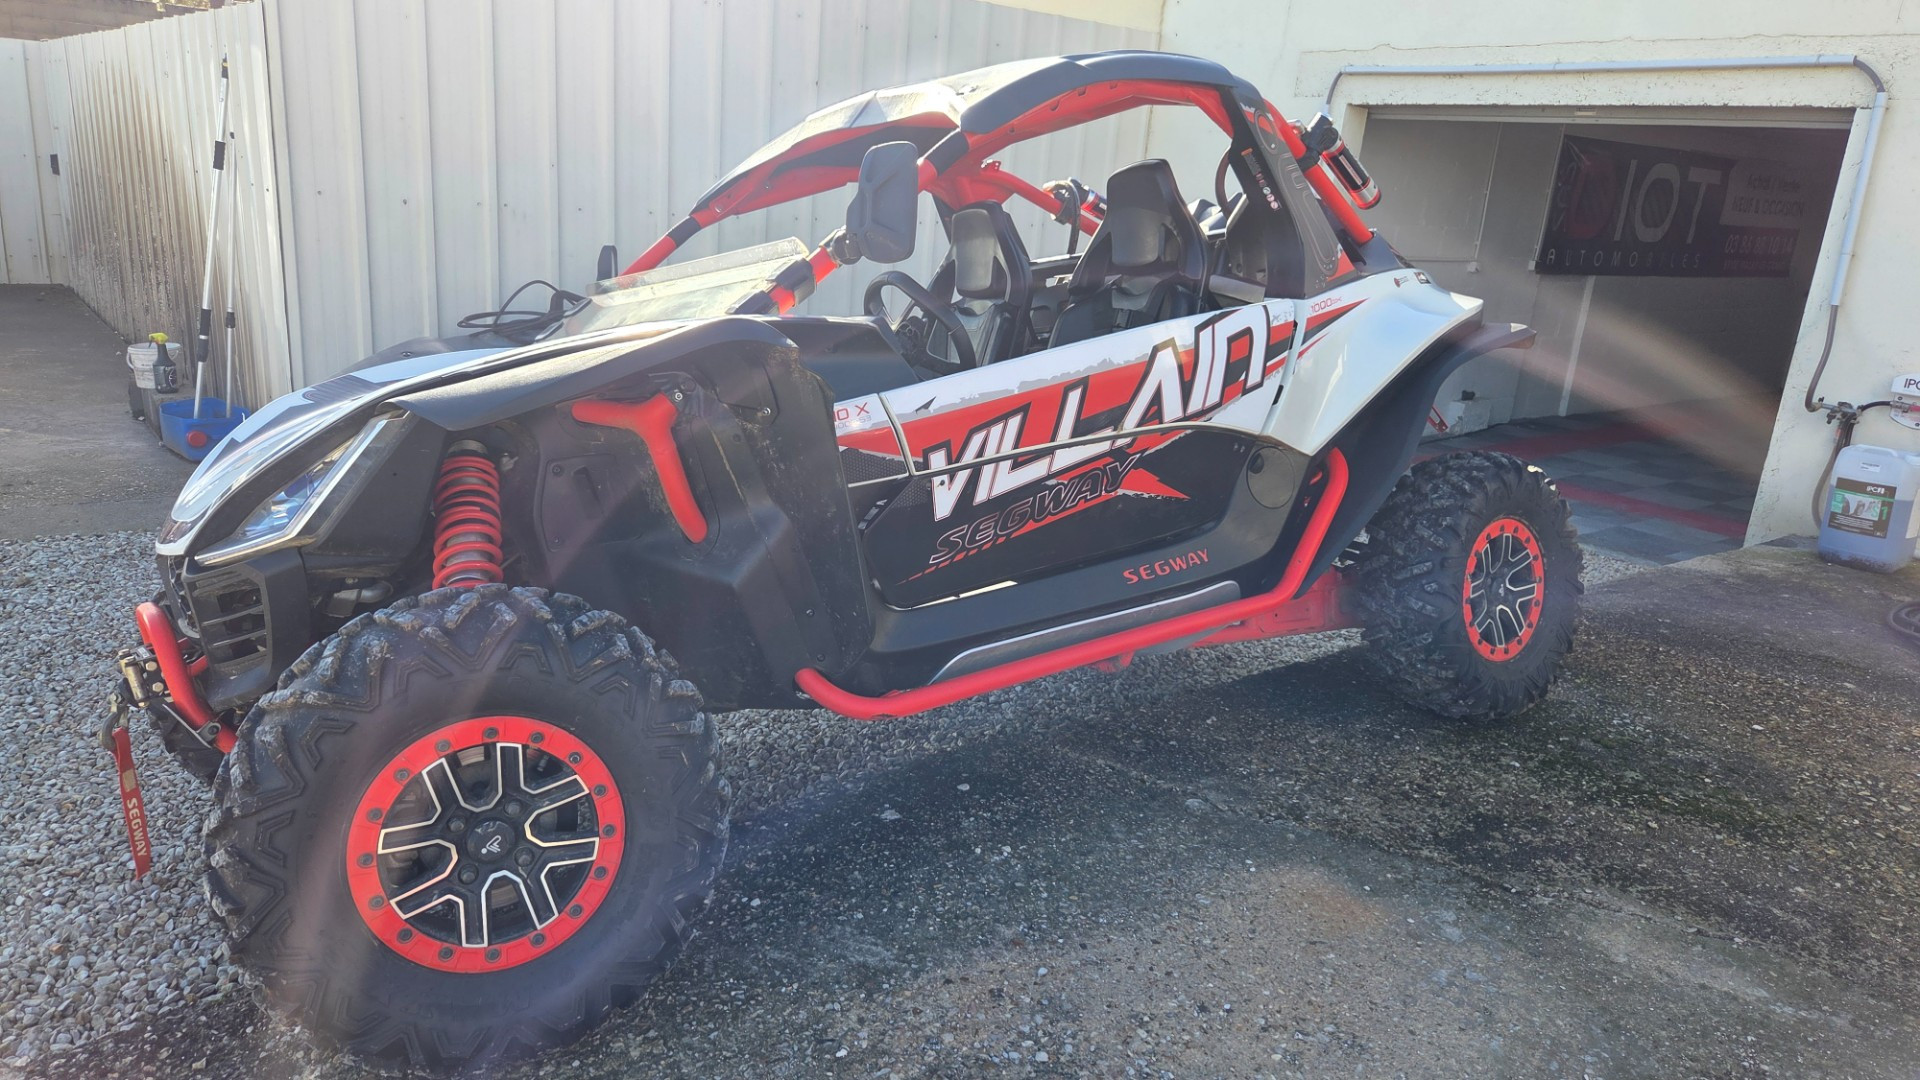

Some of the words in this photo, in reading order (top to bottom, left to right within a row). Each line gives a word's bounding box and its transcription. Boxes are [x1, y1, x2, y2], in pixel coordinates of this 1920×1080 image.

[1566, 154, 1722, 244] DIOT
[1546, 249, 1700, 269] AUTOMOBILES
[925, 305, 1269, 521] VILLAIN
[929, 454, 1138, 565] SEGWAY
[1123, 548, 1210, 584] SEGWAY
[126, 797, 148, 857] SEGWAY
